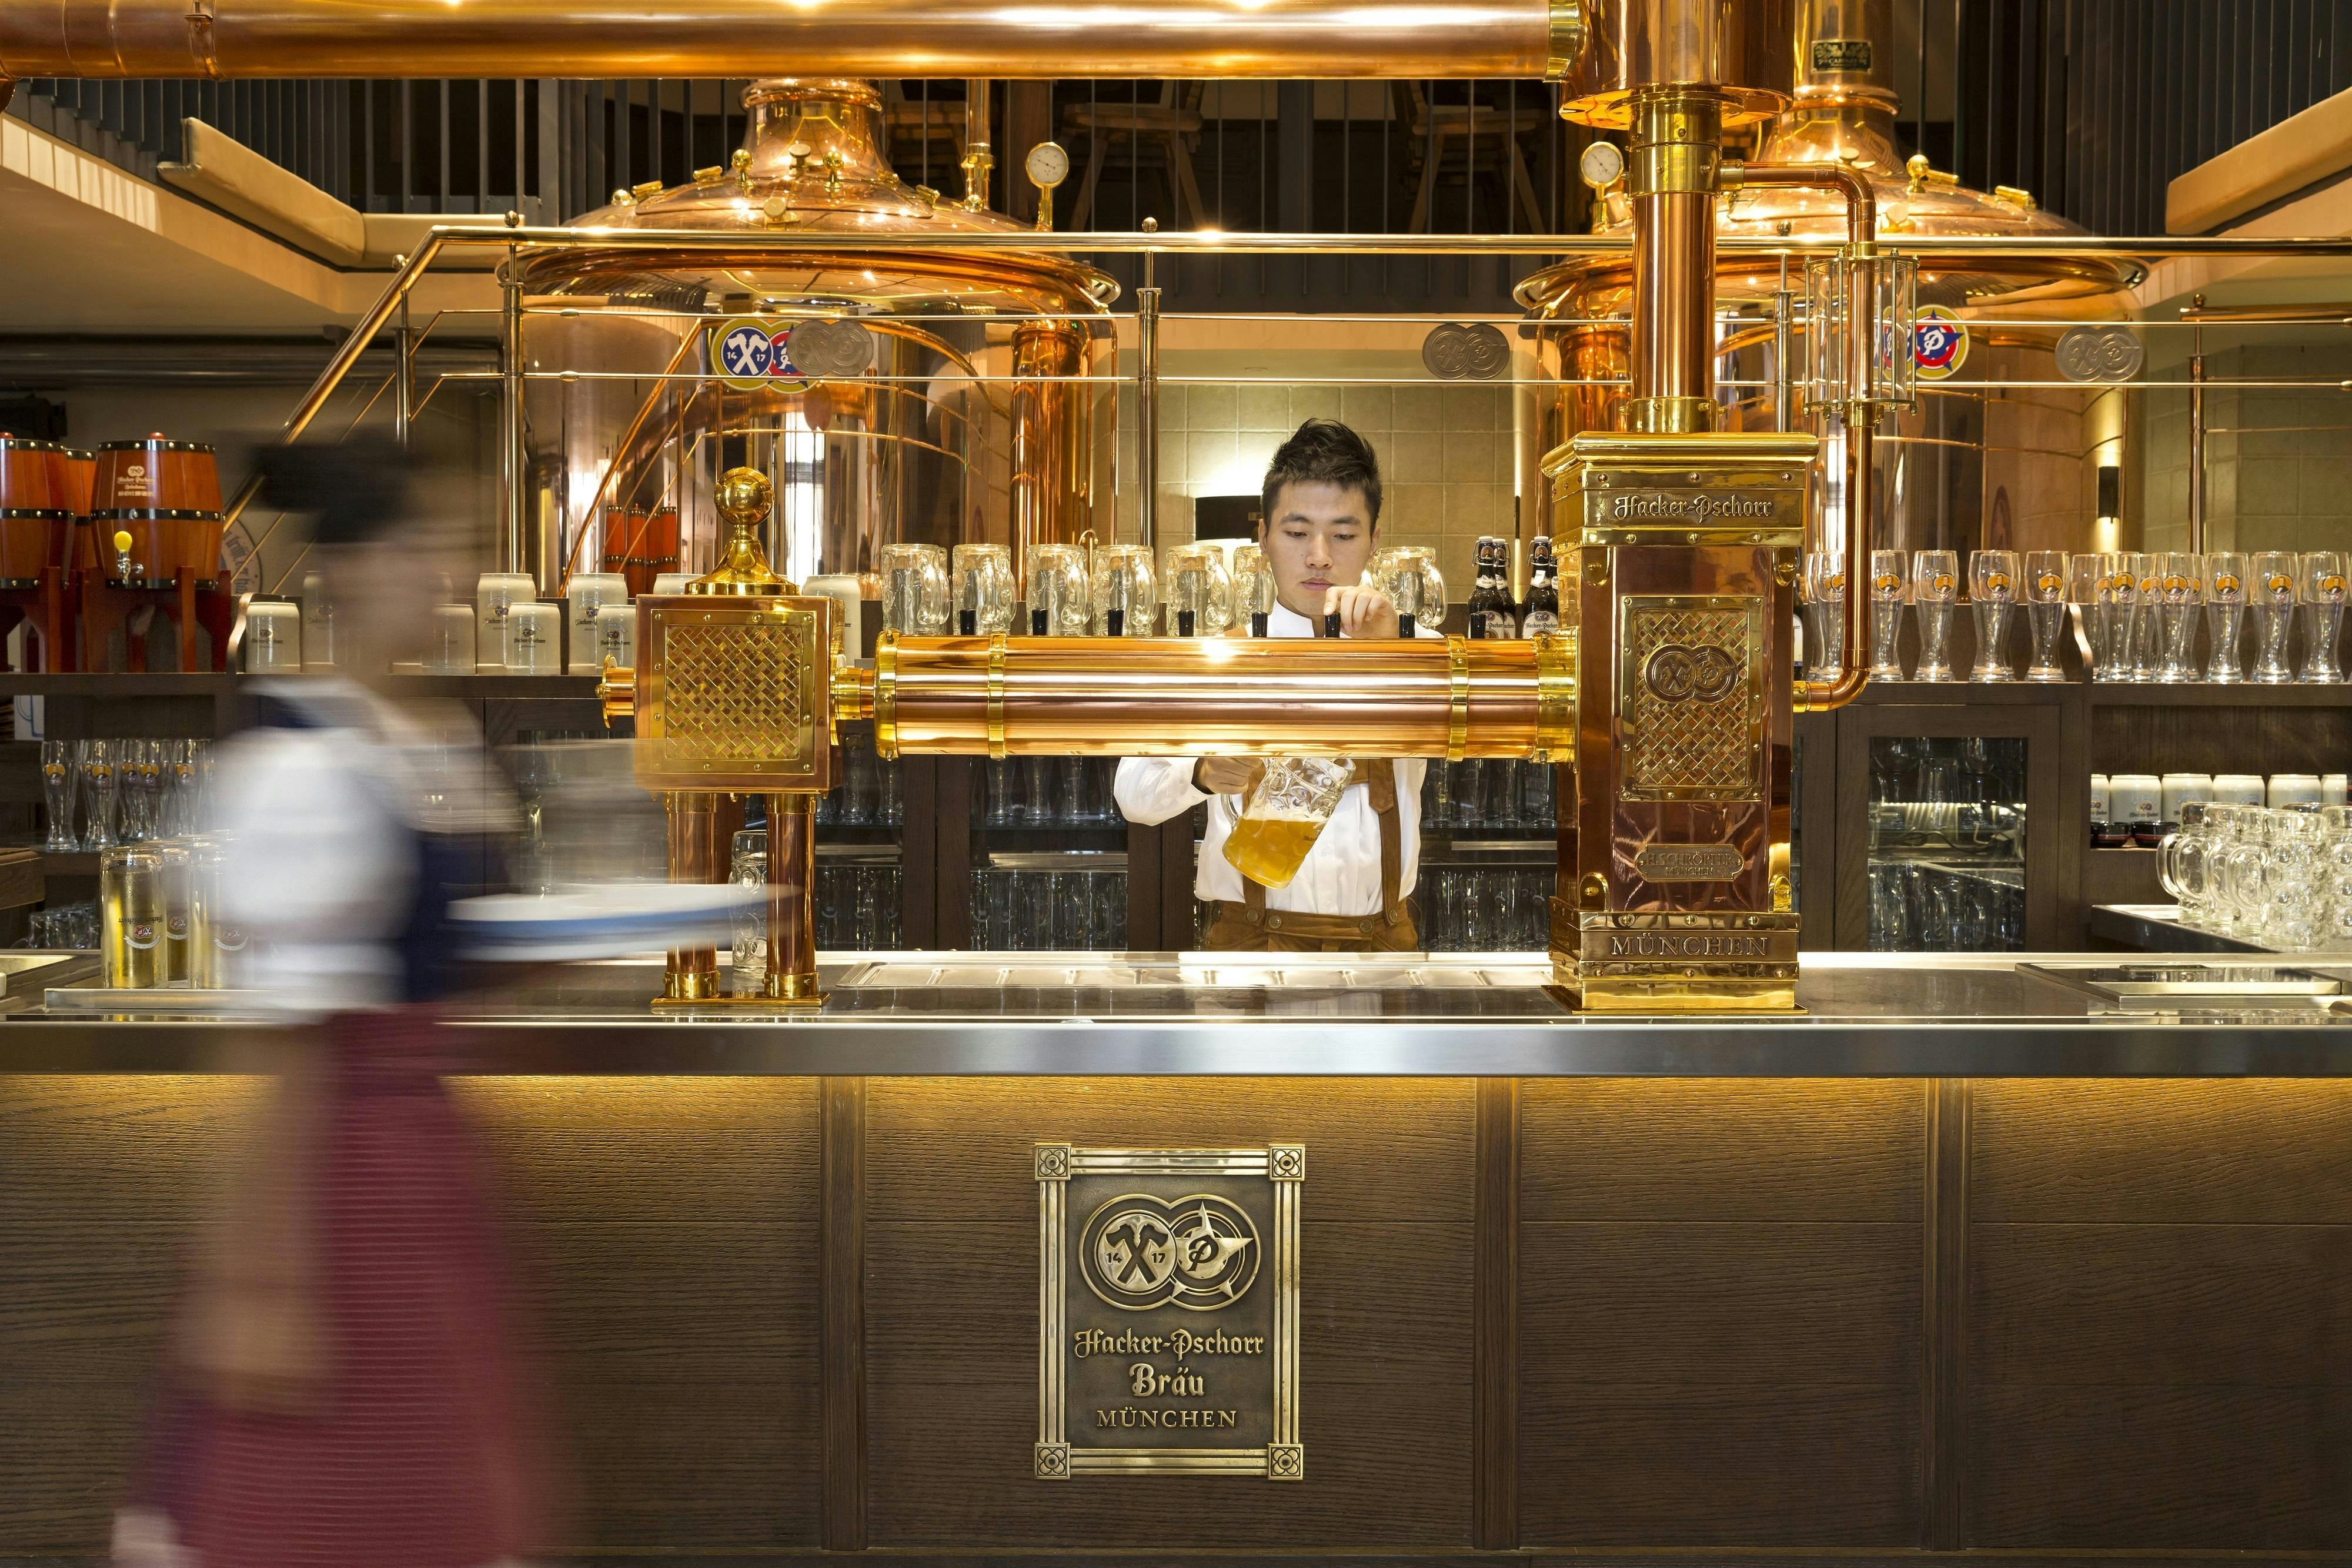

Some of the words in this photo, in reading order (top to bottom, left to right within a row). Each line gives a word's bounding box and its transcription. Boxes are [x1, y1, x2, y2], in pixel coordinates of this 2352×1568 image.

[1923, 329, 1945, 355] P
[756, 354, 766, 362] 17
[1615, 494, 1772, 523] Hacker-Pschorr
[1665, 866, 1713, 875] MÜNCHEN
[1611, 932, 1768, 956] MÜNCHEN
[1106, 1252, 1122, 1263] 14
[1151, 1252, 1166, 1263] 17
[1188, 1234, 1220, 1272] P
[1074, 1328, 1265, 1362] Hacker-Pschorr
[1128, 1363, 1205, 1398] Bräu
[1096, 1406, 1237, 1428] MÜNCHEN
